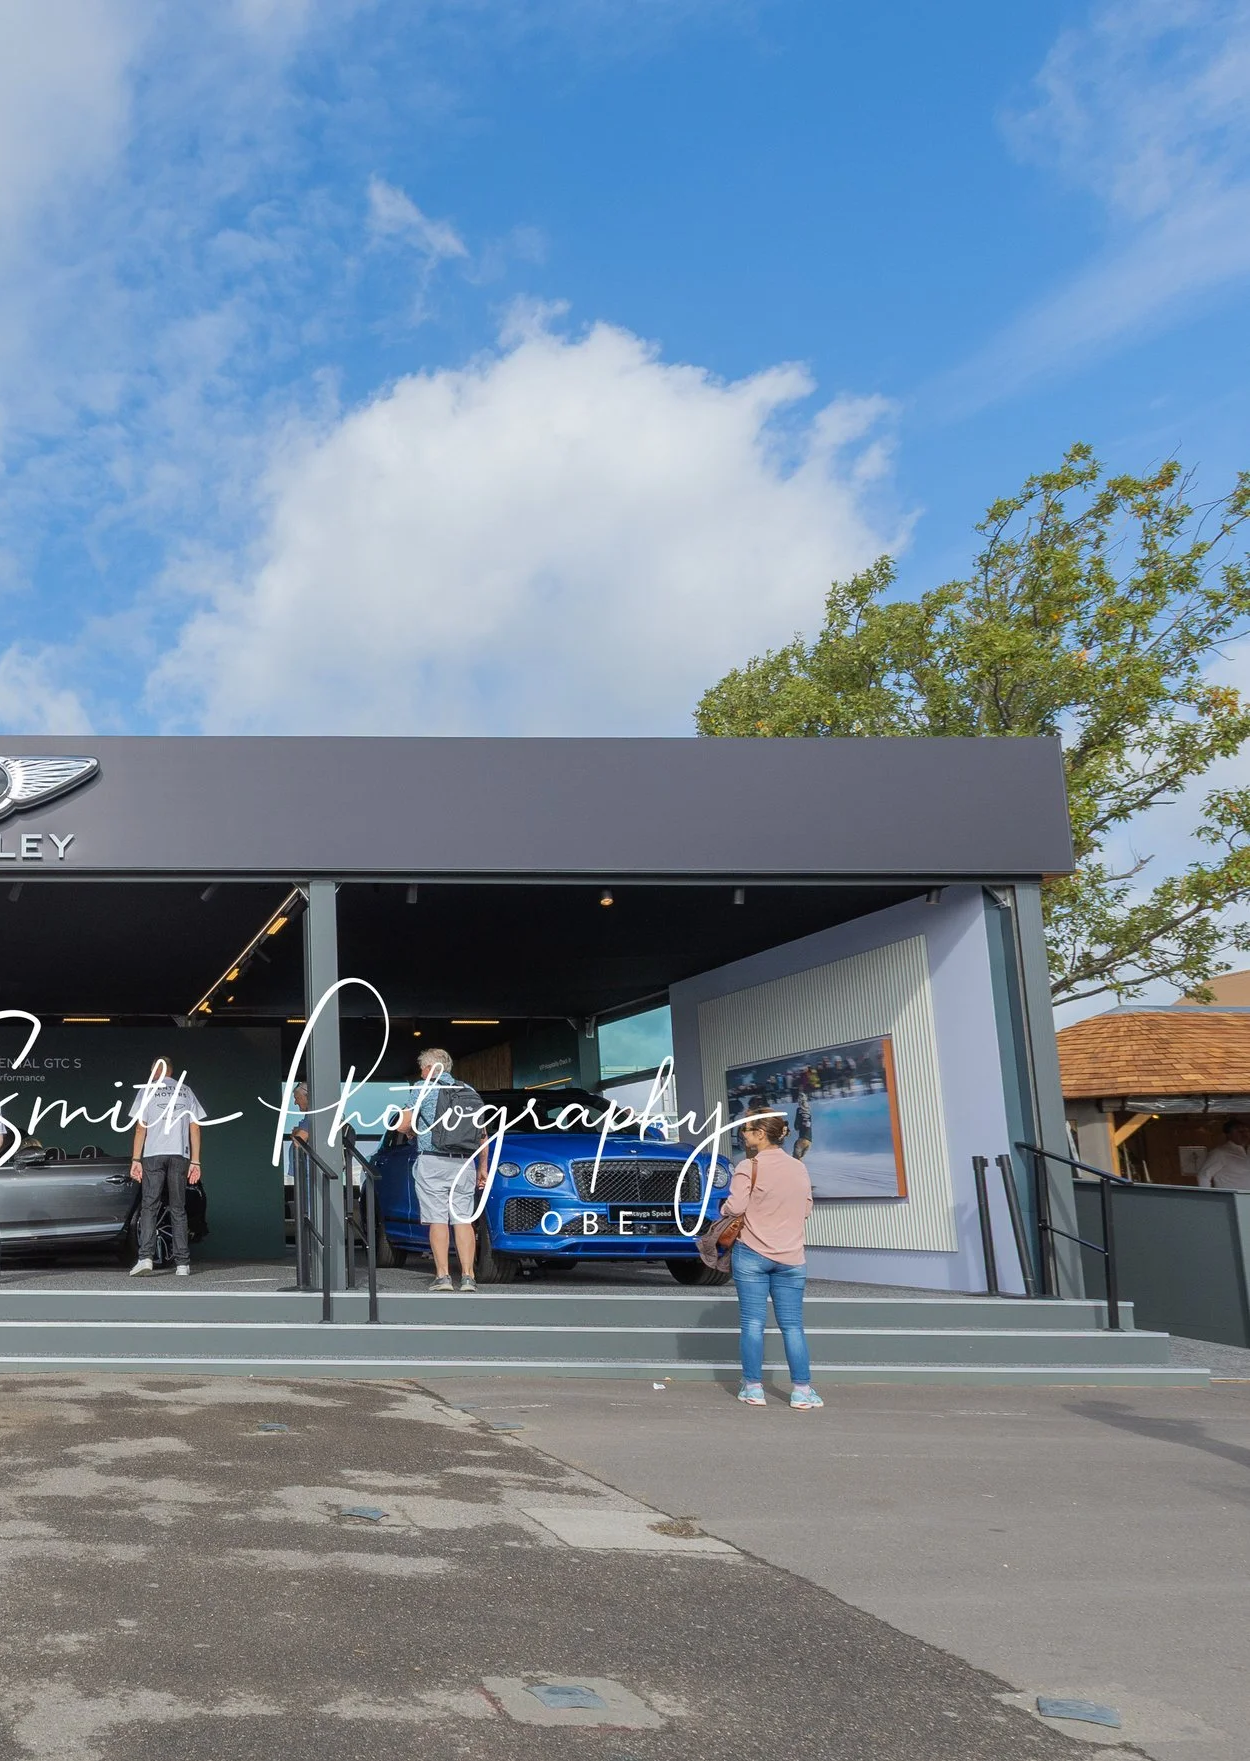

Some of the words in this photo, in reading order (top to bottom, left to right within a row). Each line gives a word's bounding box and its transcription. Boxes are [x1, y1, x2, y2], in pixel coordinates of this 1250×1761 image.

[43, 1057, 70, 1069] GTC
[73, 1057, 82, 1069] S
[651, 1210, 672, 1218] Speed
